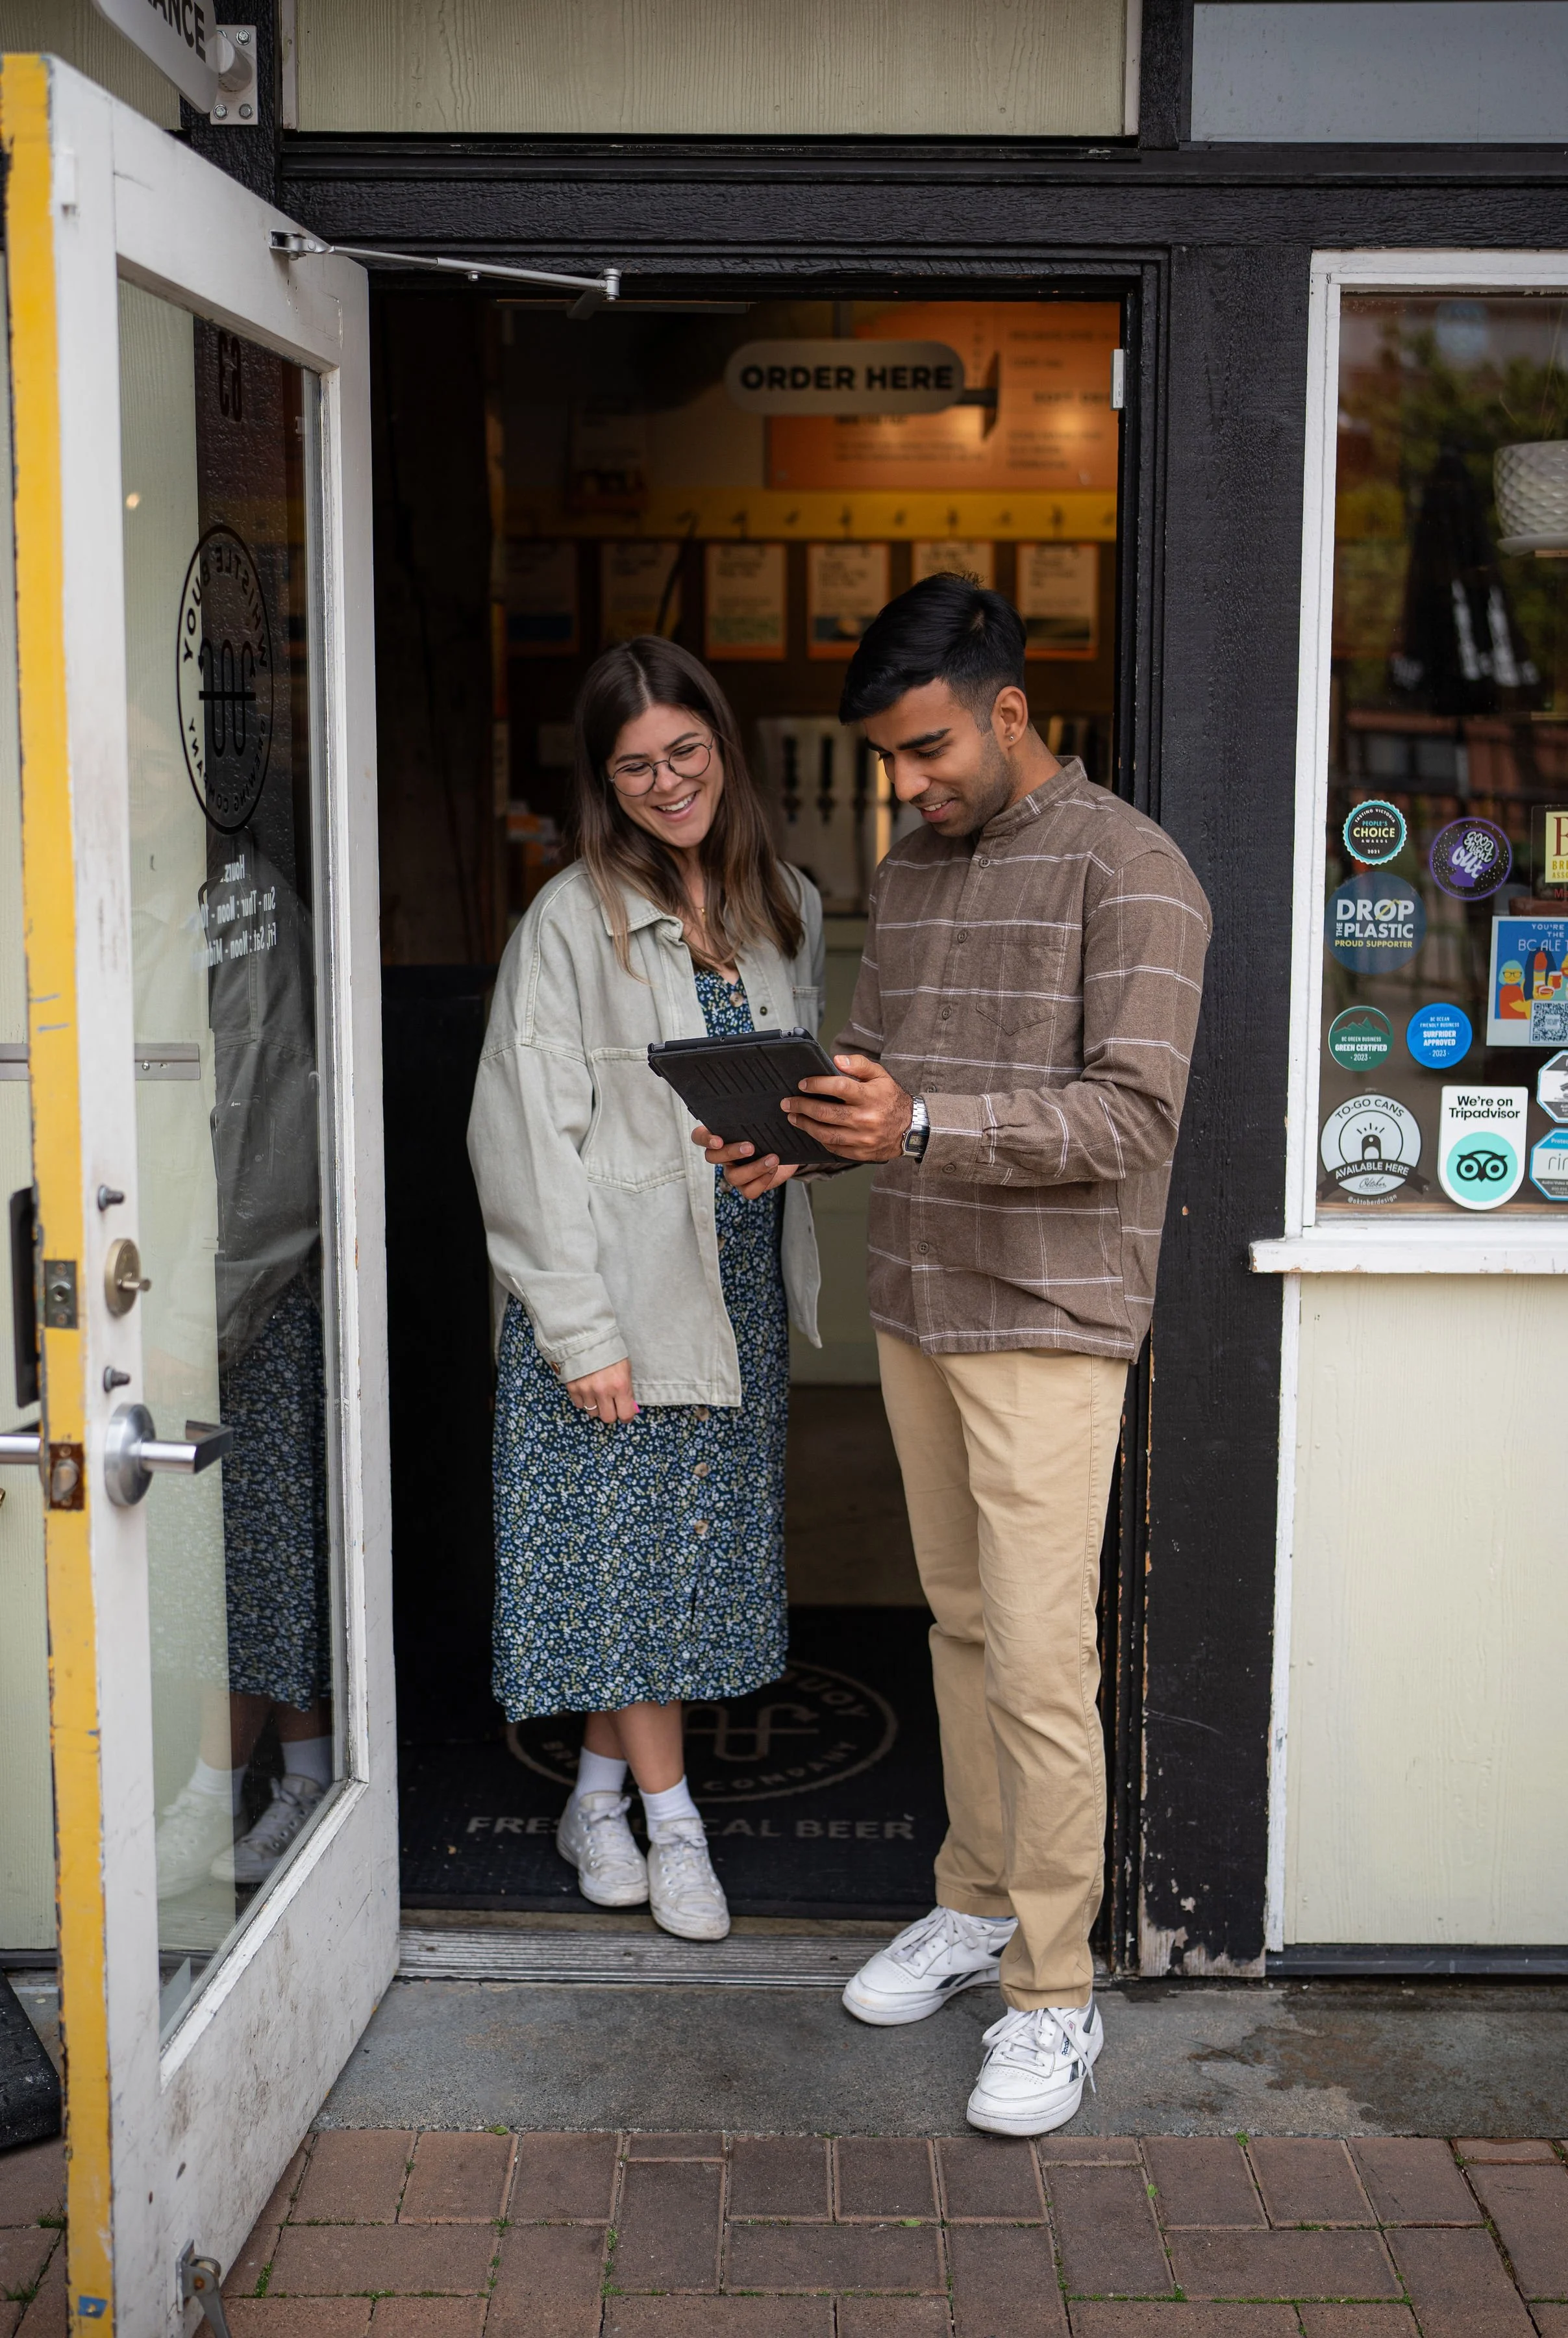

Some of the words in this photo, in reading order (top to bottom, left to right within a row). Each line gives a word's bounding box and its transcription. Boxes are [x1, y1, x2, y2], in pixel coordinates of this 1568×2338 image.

[740, 365, 856, 390] ORDER
[867, 365, 954, 390] HERE
[1354, 809, 1373, 823] TASTING
[1353, 827, 1395, 838] CHOICE
[1336, 899, 1415, 922] DROP
[1344, 923, 1414, 938] PLASTIC
[1518, 938, 1537, 951] BC
[1540, 938, 1561, 952] ALE
[1457, 1096, 1493, 1106] We're
[1335, 1099, 1371, 1119] TO-GO
[1375, 1099, 1405, 1118] CANS
[1449, 1107, 1521, 1120] Tripadvisor
[1336, 1162, 1383, 1180] AVAILABLE
[1385, 1163, 1410, 1176] HERE
[1347, 1194, 1397, 1206] @oktoberdesign
[775, 1670, 871, 1718] UOY
[466, 1816, 560, 1834] FRE
[796, 1820, 915, 1840] BEER
